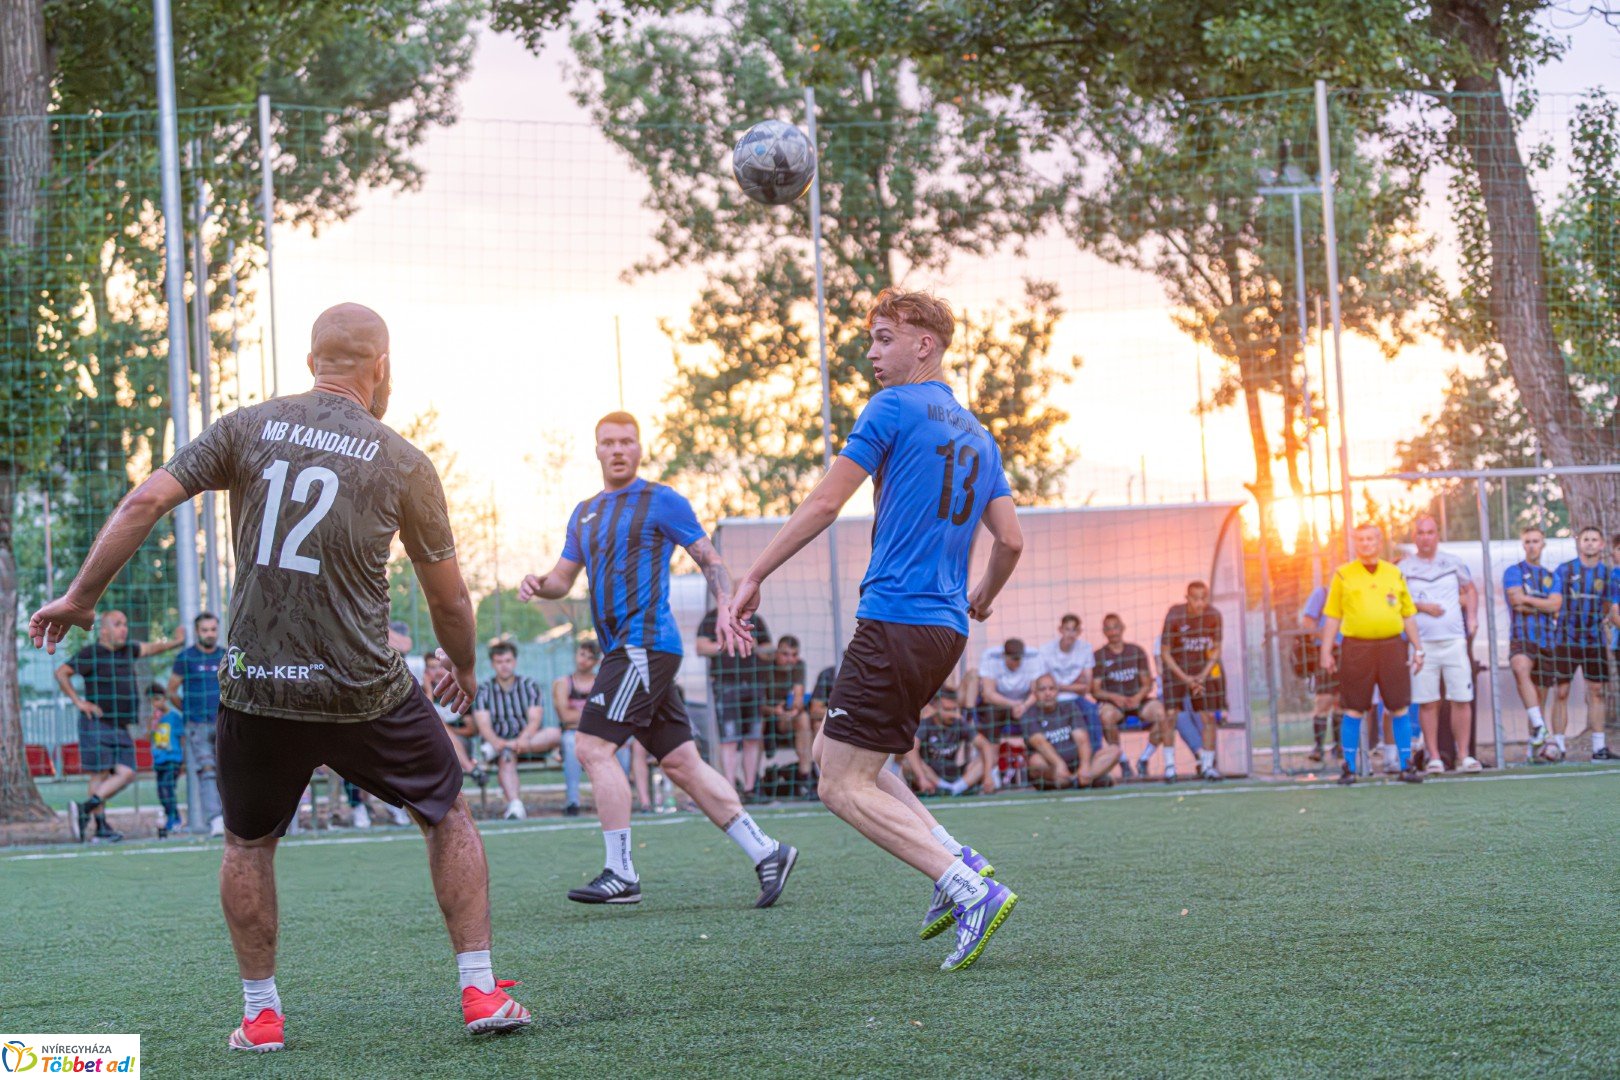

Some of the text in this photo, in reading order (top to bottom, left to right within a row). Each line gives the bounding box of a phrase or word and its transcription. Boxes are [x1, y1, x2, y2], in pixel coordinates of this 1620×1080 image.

[927, 403, 945, 422] MB
[261, 419, 381, 462] MB KANDALLÓ
[936, 438, 980, 526] 13
[256, 459, 339, 575] 12
[247, 663, 325, 679] PA-KER PRO
